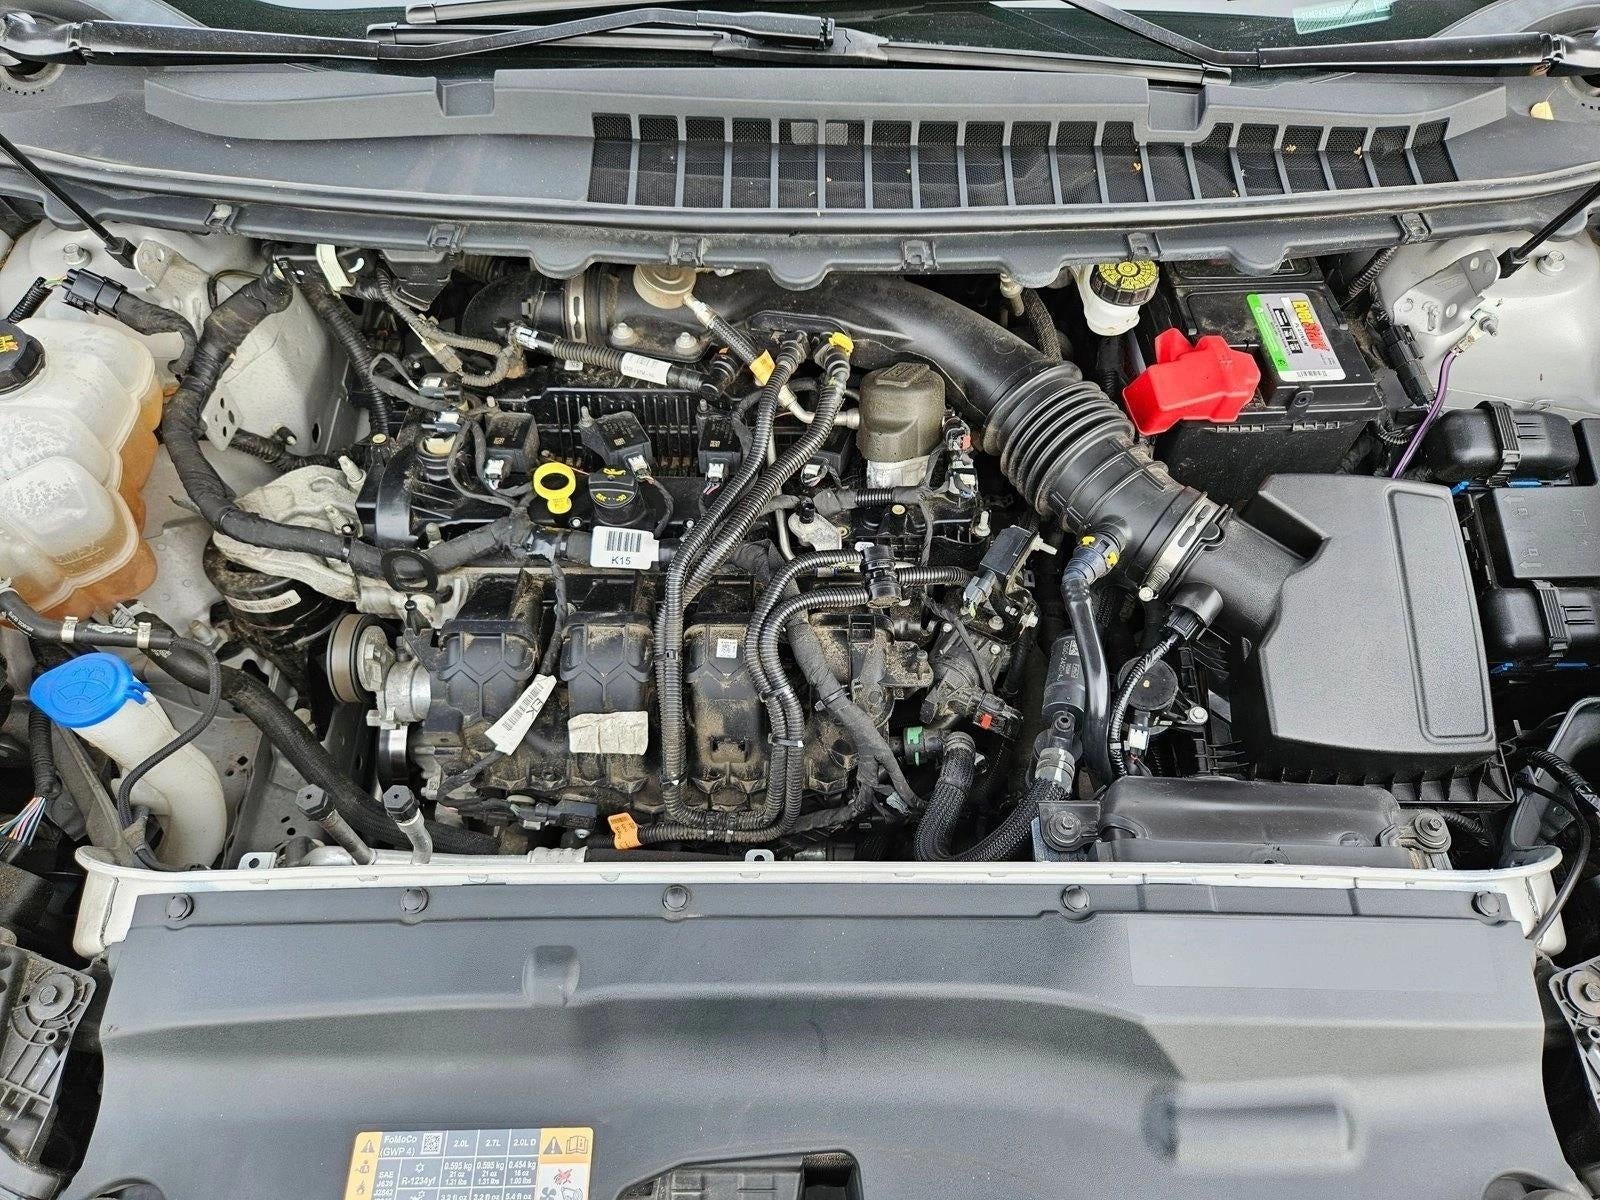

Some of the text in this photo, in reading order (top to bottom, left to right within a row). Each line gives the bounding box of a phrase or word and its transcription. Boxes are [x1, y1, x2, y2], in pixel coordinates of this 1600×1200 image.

[611, 556, 631, 566] K15
[526, 698, 544, 719] EK
[384, 1134, 418, 1144] FoMoCo
[454, 1139, 470, 1149] 2.0L
[485, 1138, 501, 1148] 2.7L
[513, 1138, 537, 1147] 2.0L D
[380, 1147, 416, 1158] (GWP 4)
[463, 1161, 473, 1171] kg
[476, 1161, 504, 1171] 0.595 kg
[527, 1161, 536, 1170] kg
[379, 1171, 394, 1179] SAE
[402, 1176, 436, 1187] R-1234yf
